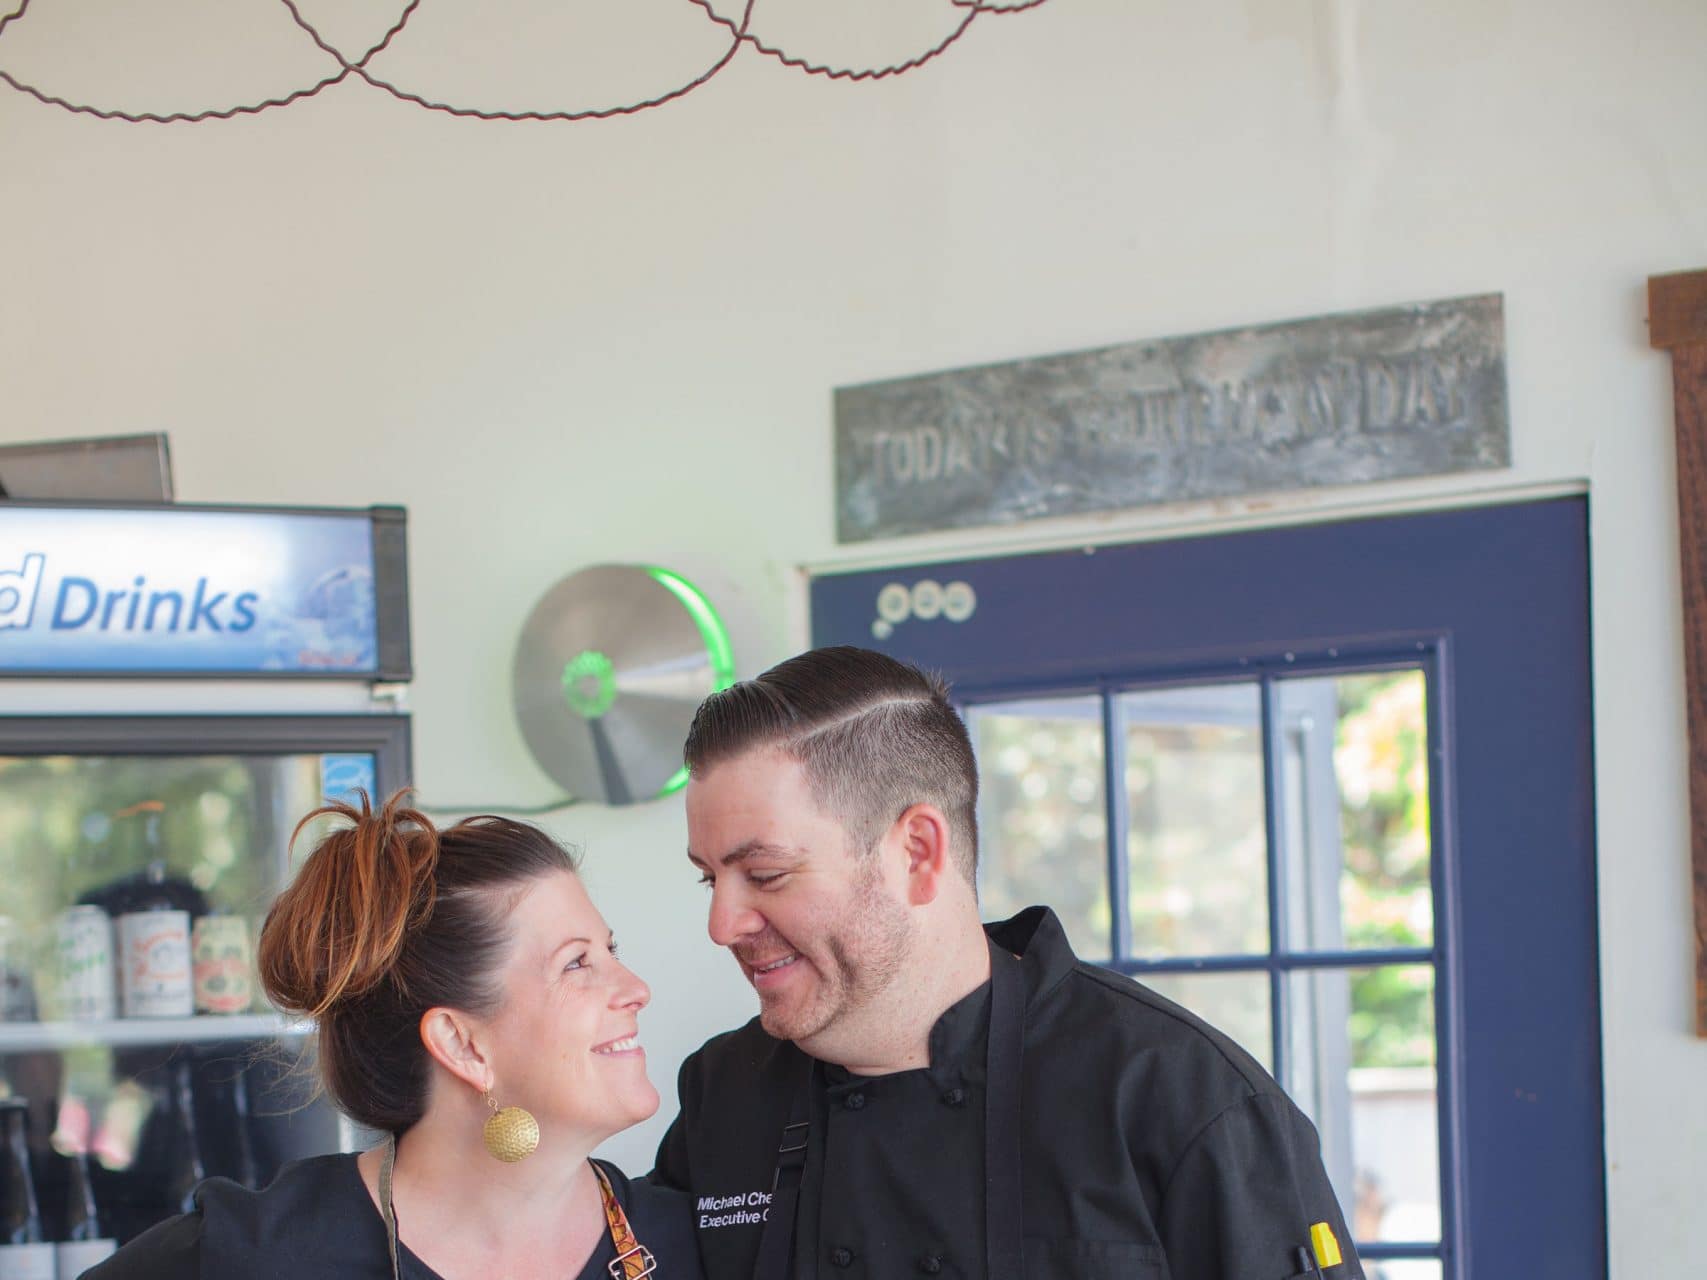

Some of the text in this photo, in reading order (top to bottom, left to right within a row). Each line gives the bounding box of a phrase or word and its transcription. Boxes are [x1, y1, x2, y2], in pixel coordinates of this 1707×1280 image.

[870, 414, 1005, 488] TODAY
[50, 575, 258, 633] Drinks
[697, 1192, 746, 1211] Michael
[699, 1210, 761, 1229] Executive
